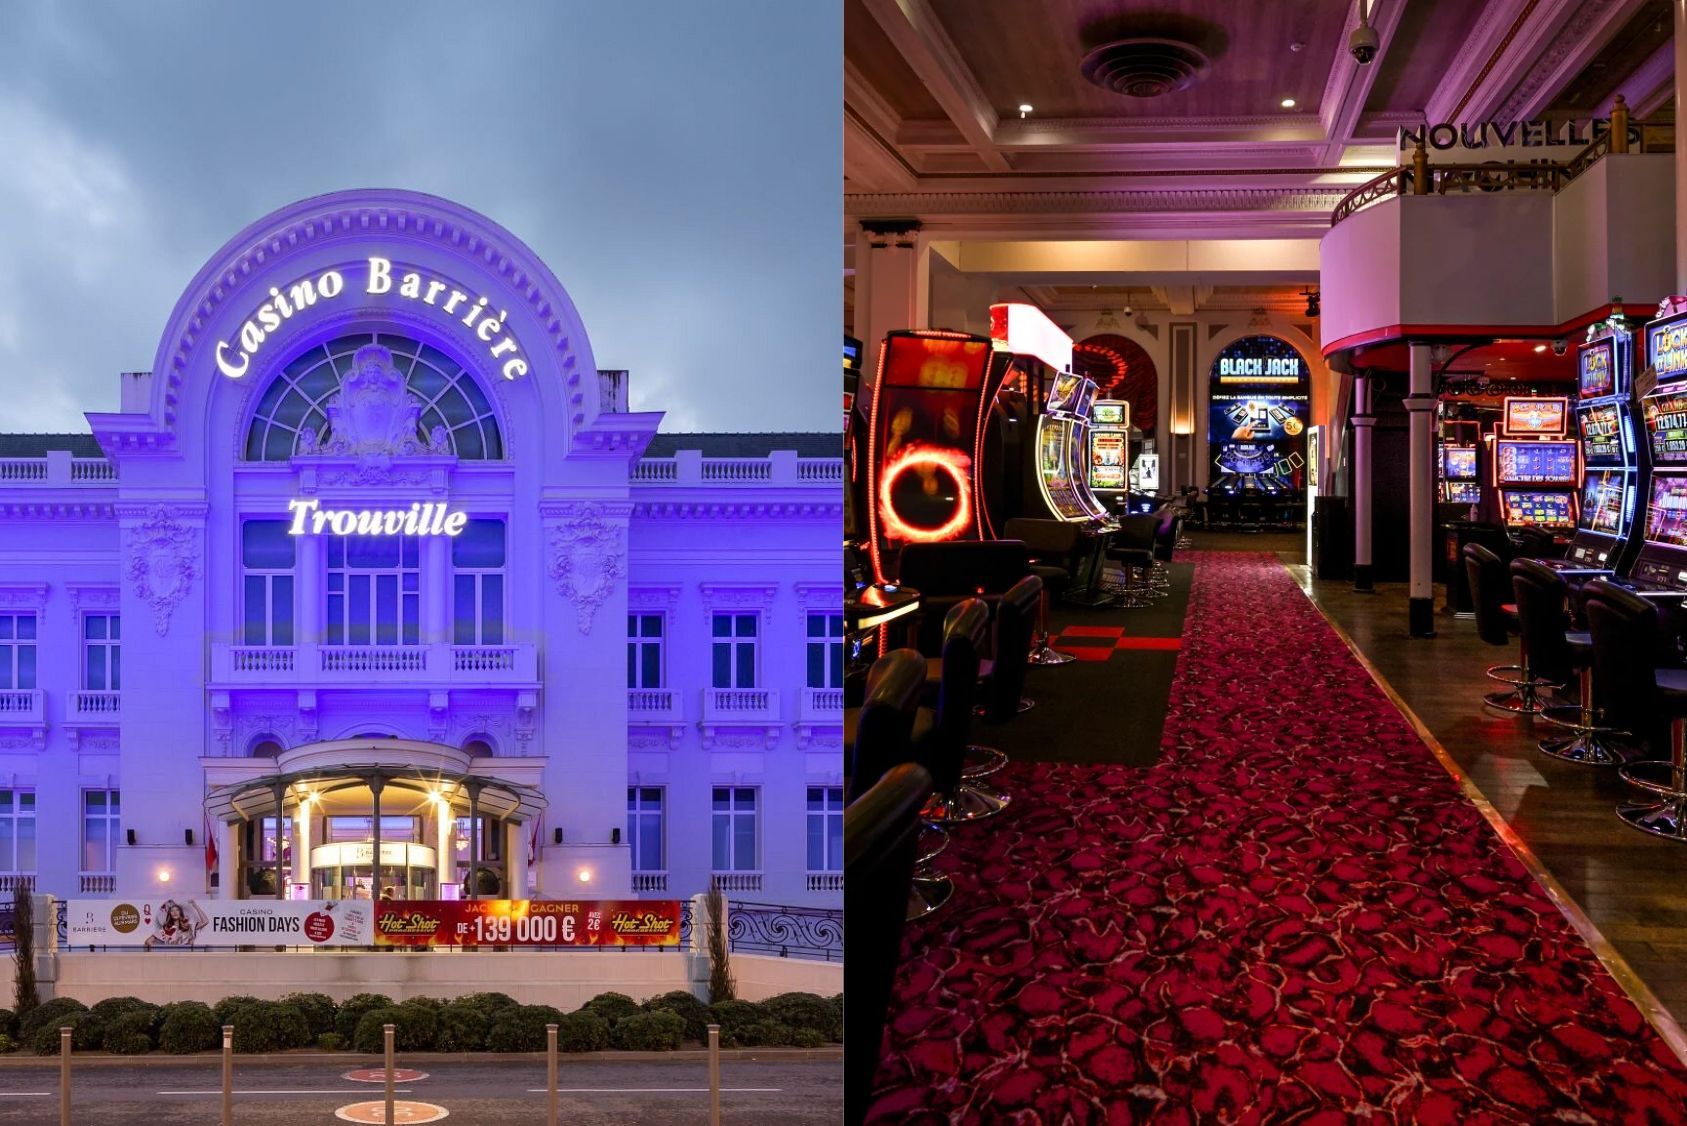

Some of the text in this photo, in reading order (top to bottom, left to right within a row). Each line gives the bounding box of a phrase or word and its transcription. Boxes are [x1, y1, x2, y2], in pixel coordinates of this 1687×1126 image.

[216, 256, 528, 381] Casino Barrière
[1220, 358, 1299, 375] BLACK JACK
[288, 498, 468, 536] Trouville
[530, 904, 579, 913] GAGNER
[213, 917, 257, 932] FASHION
[260, 917, 300, 932] DAYS
[379, 913, 406, 933] Hot
[406, 913, 440, 930] Shot
[457, 923, 468, 934] DE
[612, 913, 673, 933] Hot Shot
